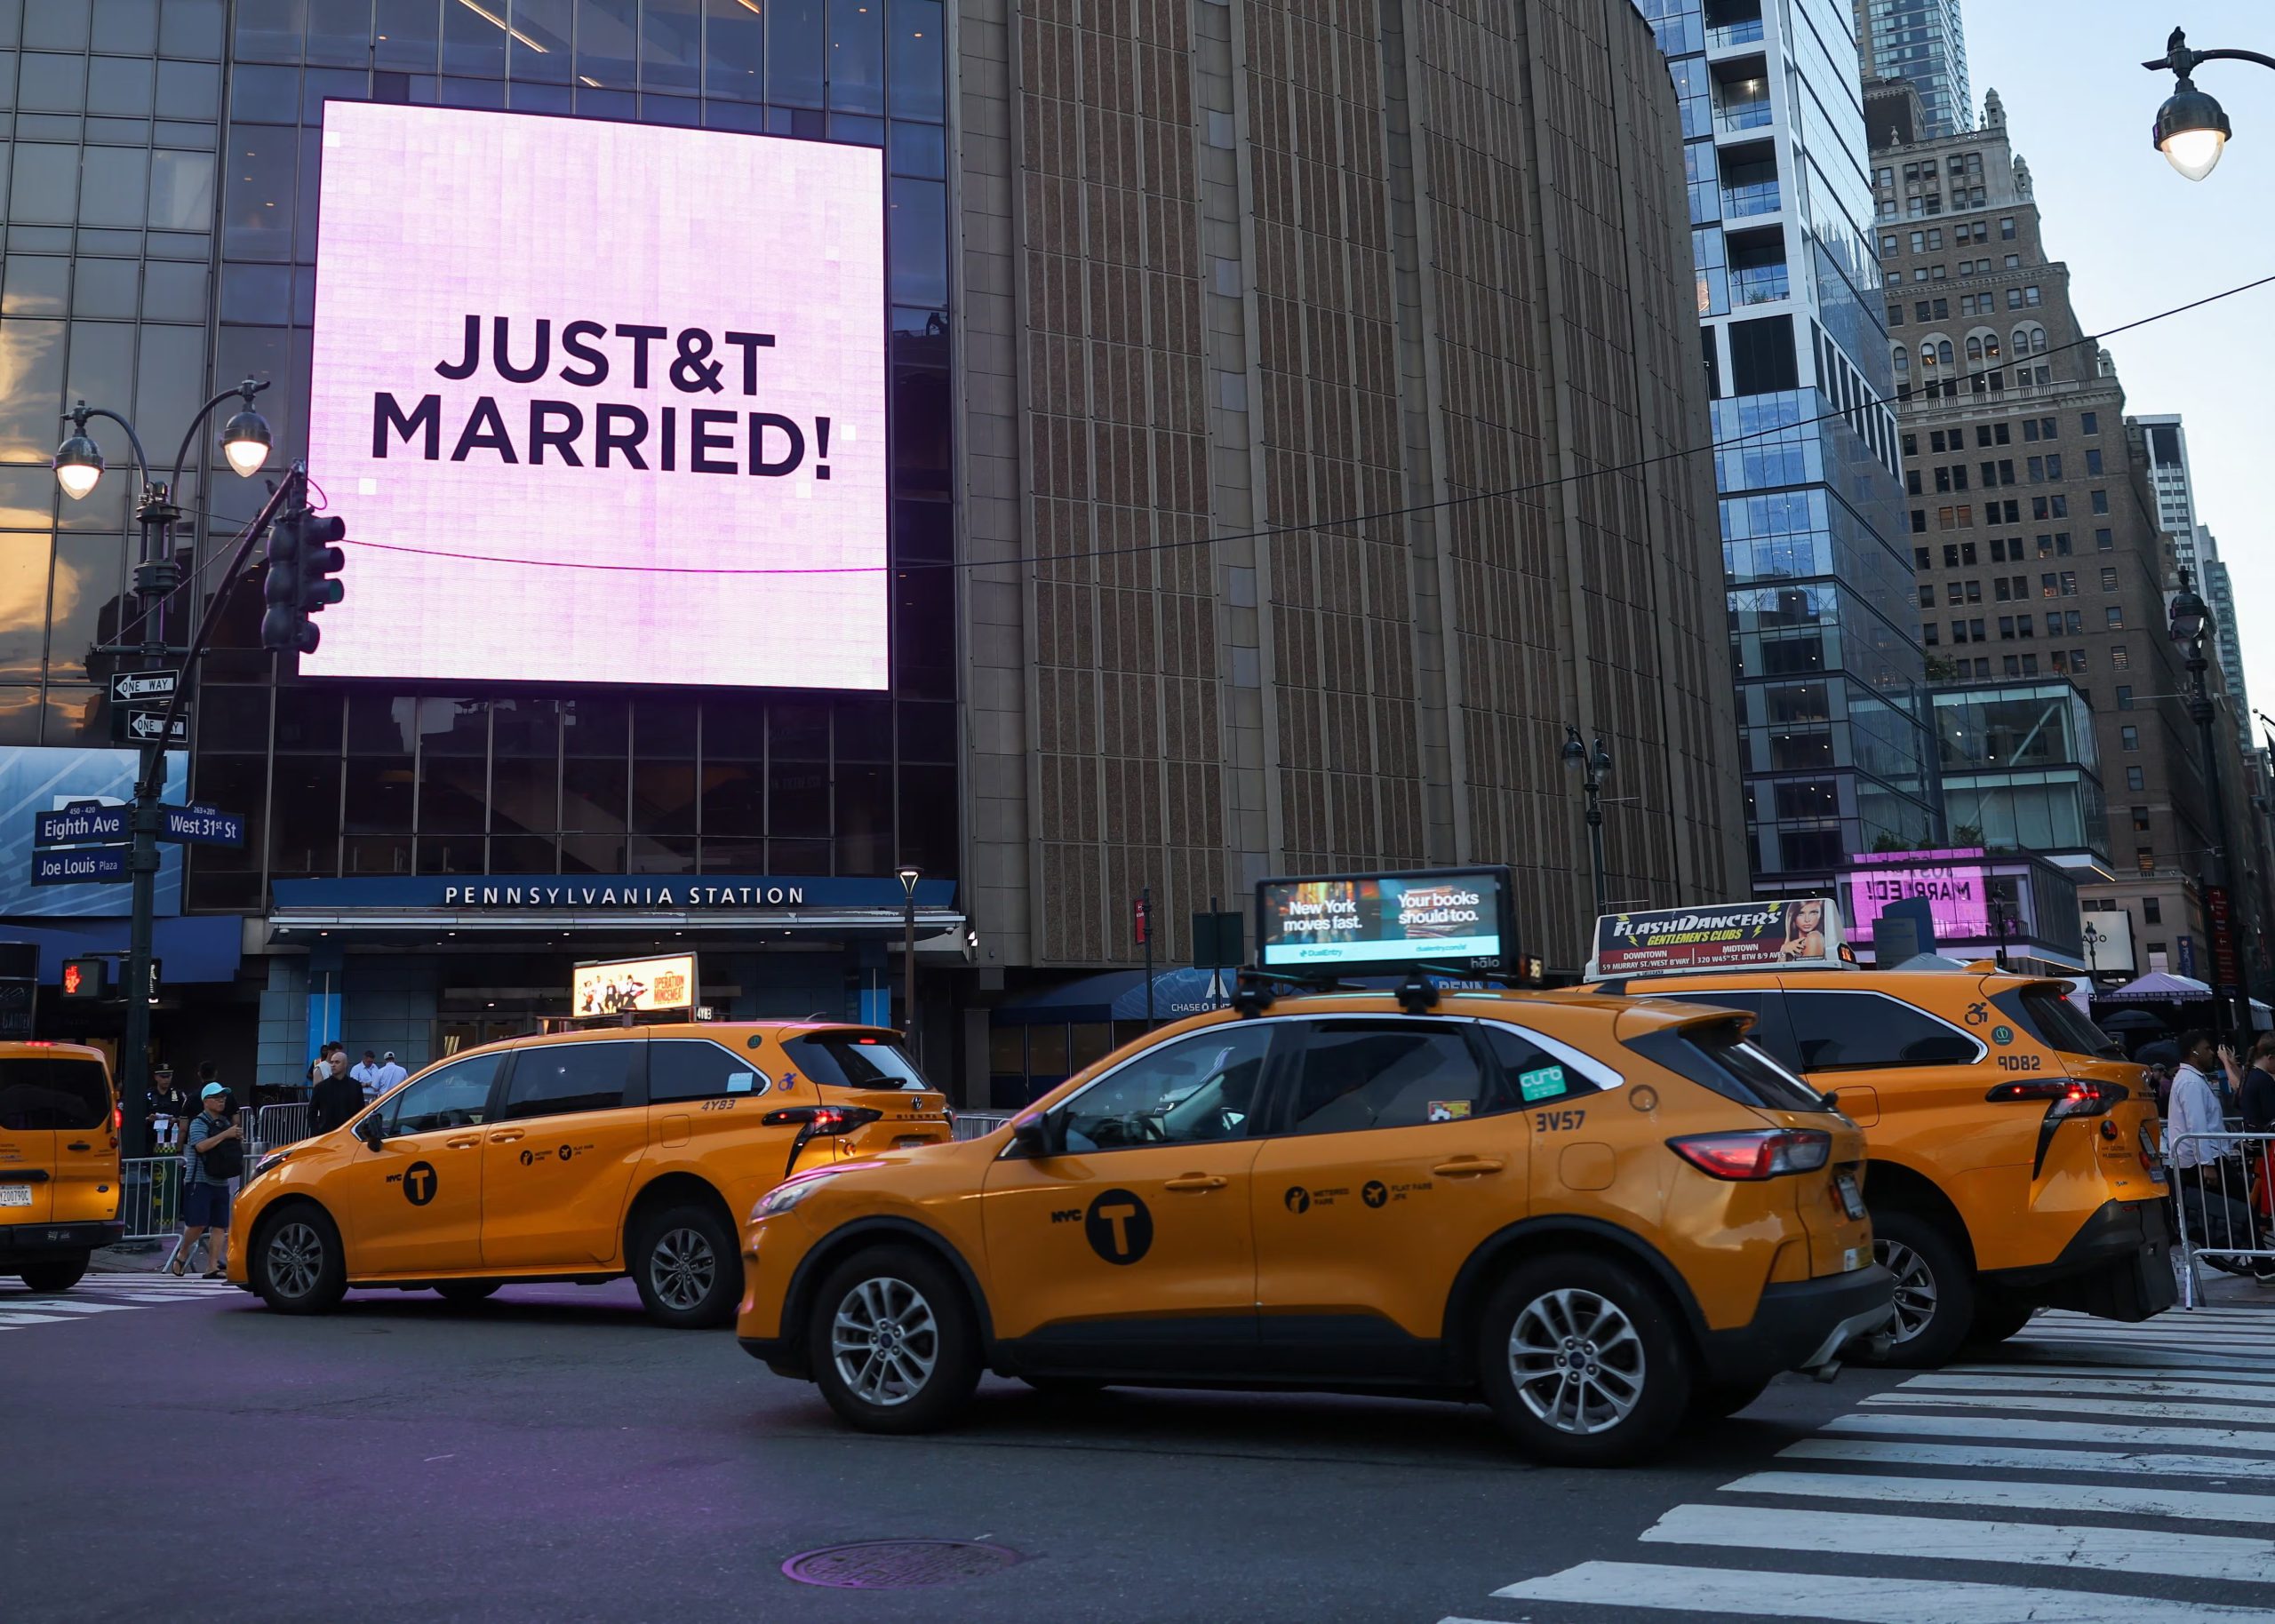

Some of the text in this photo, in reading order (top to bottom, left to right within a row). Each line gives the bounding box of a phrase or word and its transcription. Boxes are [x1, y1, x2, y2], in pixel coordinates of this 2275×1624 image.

[434, 314, 777, 397] JUST&T
[372, 391, 832, 481] MARRIED!
[122, 679, 168, 693] ONE WAY
[137, 719, 155, 731] ONE
[44, 816, 120, 840] Eighth Ave
[170, 815, 236, 839] West 31st St
[41, 857, 117, 876] Joe Louis Plaza
[445, 887, 803, 904] PENNSYLVANIA STATION
[1398, 891, 1480, 909] Your books
[1289, 899, 1356, 916] New York
[1398, 907, 1479, 925] should too.
[1283, 915, 1362, 933] moves fast.
[1647, 928, 1743, 946] GENTLEMEN'S CLUBS
[1308, 947, 1343, 959] DualEntry
[1623, 950, 1668, 960] DOWNTOWN
[1722, 943, 1759, 953] MIDTOWN
[1742, 952, 1757, 961] BTW
[1758, 951, 1768, 960] 8/9
[1612, 961, 1638, 970] MURRAY
[1669, 958, 1690, 967] B'WAY
[654, 975, 684, 989] OPERATION
[1171, 1003, 1201, 1012] CHASE
[1998, 1055, 2040, 1071] 9D82
[1521, 1068, 1563, 1087] curb
[1536, 1111, 1586, 1133] 3V57
[386, 1174, 402, 1182] NYC
[410, 1170, 430, 1200] T
[1051, 1208, 1082, 1223] NYC
[1098, 1204, 1136, 1255] T
